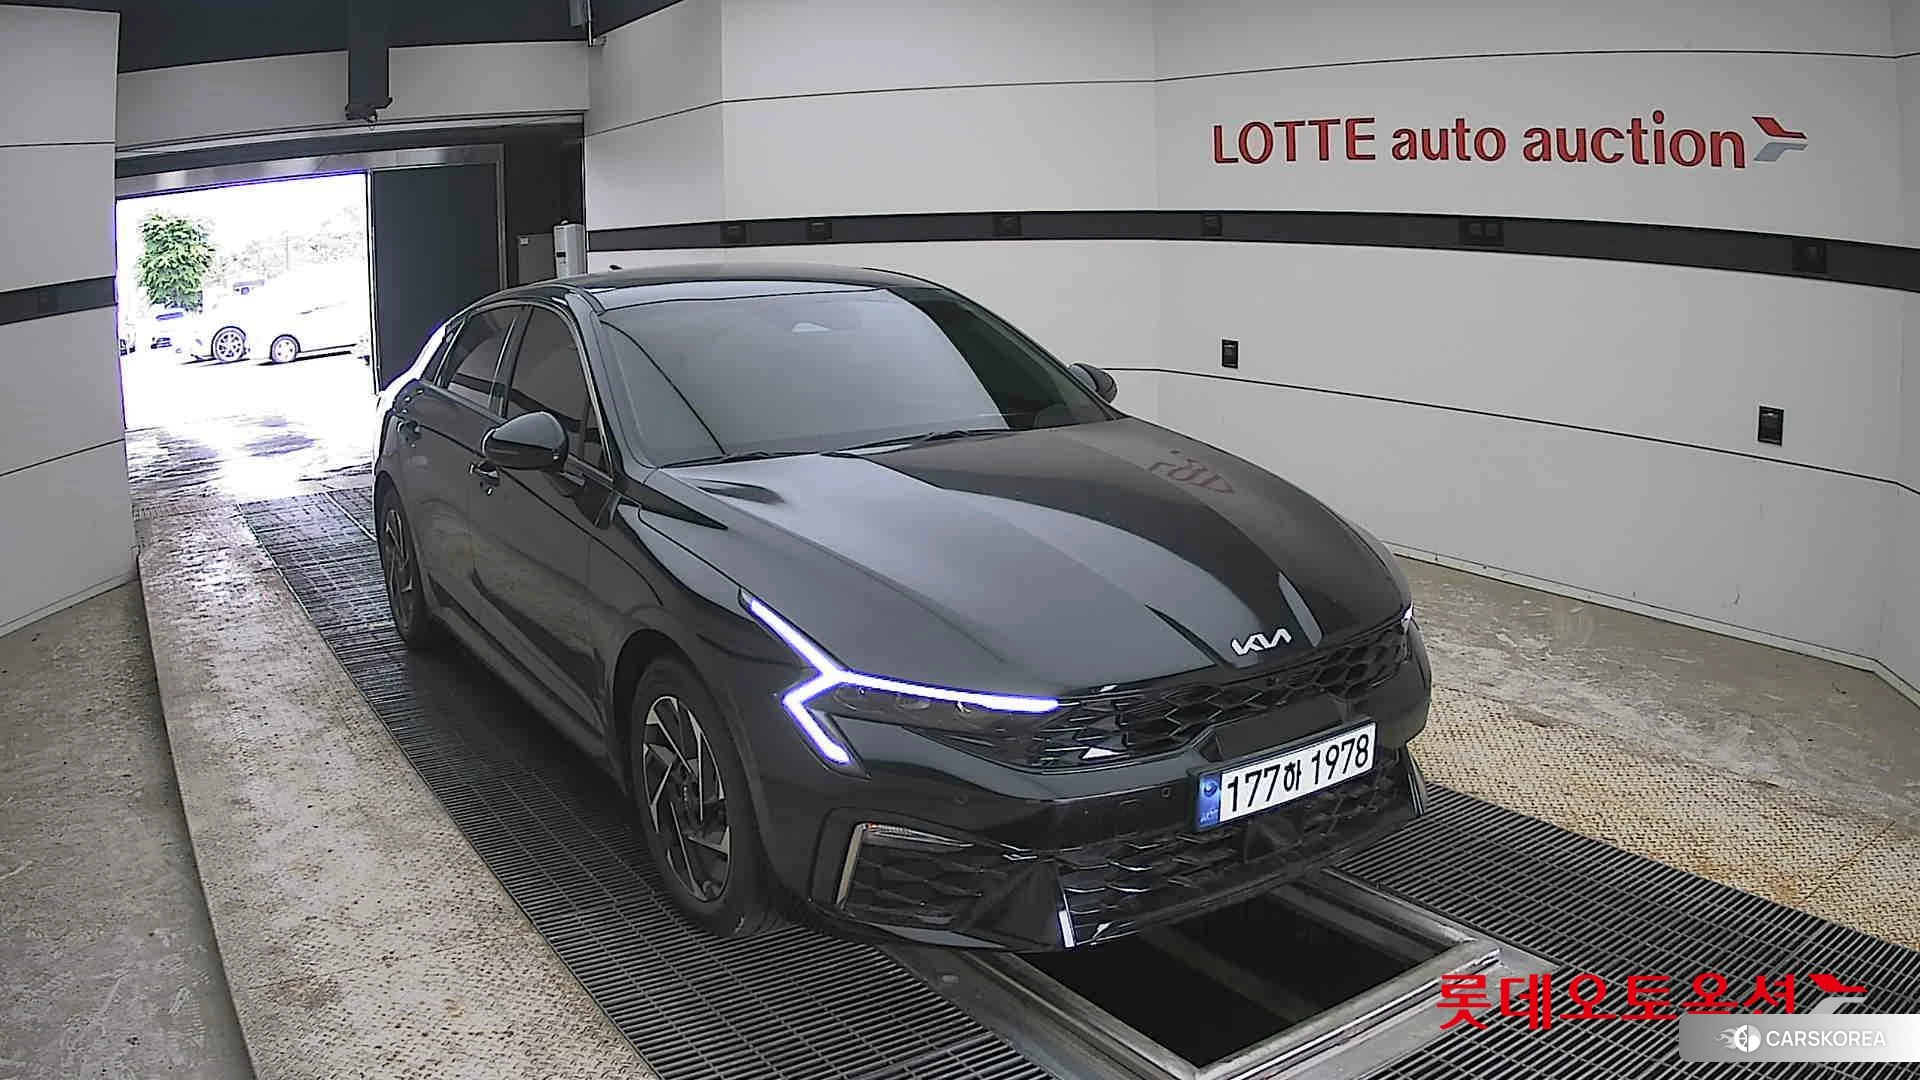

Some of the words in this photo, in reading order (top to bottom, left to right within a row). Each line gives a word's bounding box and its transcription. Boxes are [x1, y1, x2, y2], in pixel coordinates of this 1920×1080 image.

[1212, 117, 1377, 164] LOTTE
[1391, 118, 1506, 162] auto
[1522, 110, 1747, 169] auction
[1227, 759, 1302, 812] 177하
[1311, 733, 1370, 785] 1978
